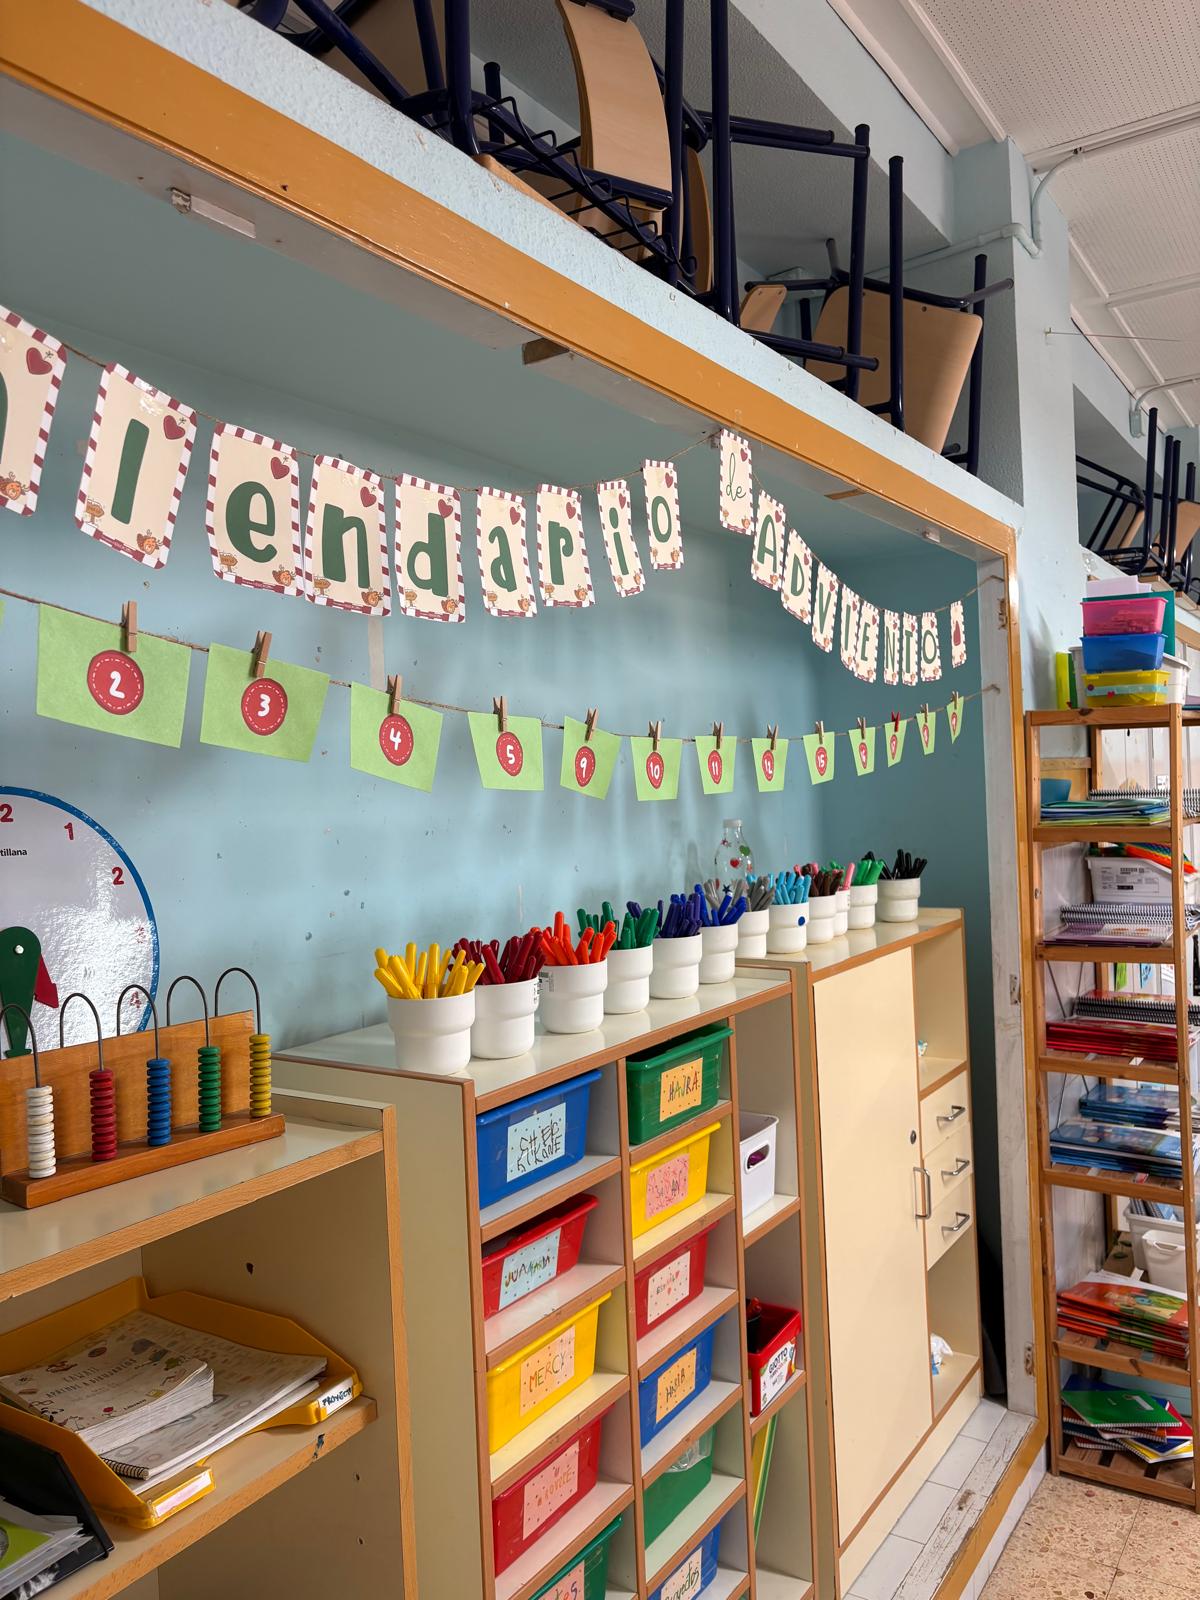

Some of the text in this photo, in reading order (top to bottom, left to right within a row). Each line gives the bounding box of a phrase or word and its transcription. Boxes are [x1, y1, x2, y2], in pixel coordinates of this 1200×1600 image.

[725, 452, 747, 502] de
[756, 513, 937, 674] ADVIENTO
[109, 671, 125, 699] 2
[257, 693, 271, 717] 3
[389, 727, 402, 751] 4
[506, 745, 516, 765] 5
[580, 756, 588, 778] 9
[650, 762, 660, 779] 10
[711, 761, 719, 775] 11
[764, 759, 774, 774] 12
[64, 822, 74, 840] 1
[111, 866, 124, 885] 2
[529, 1351, 567, 1392] MERCY
